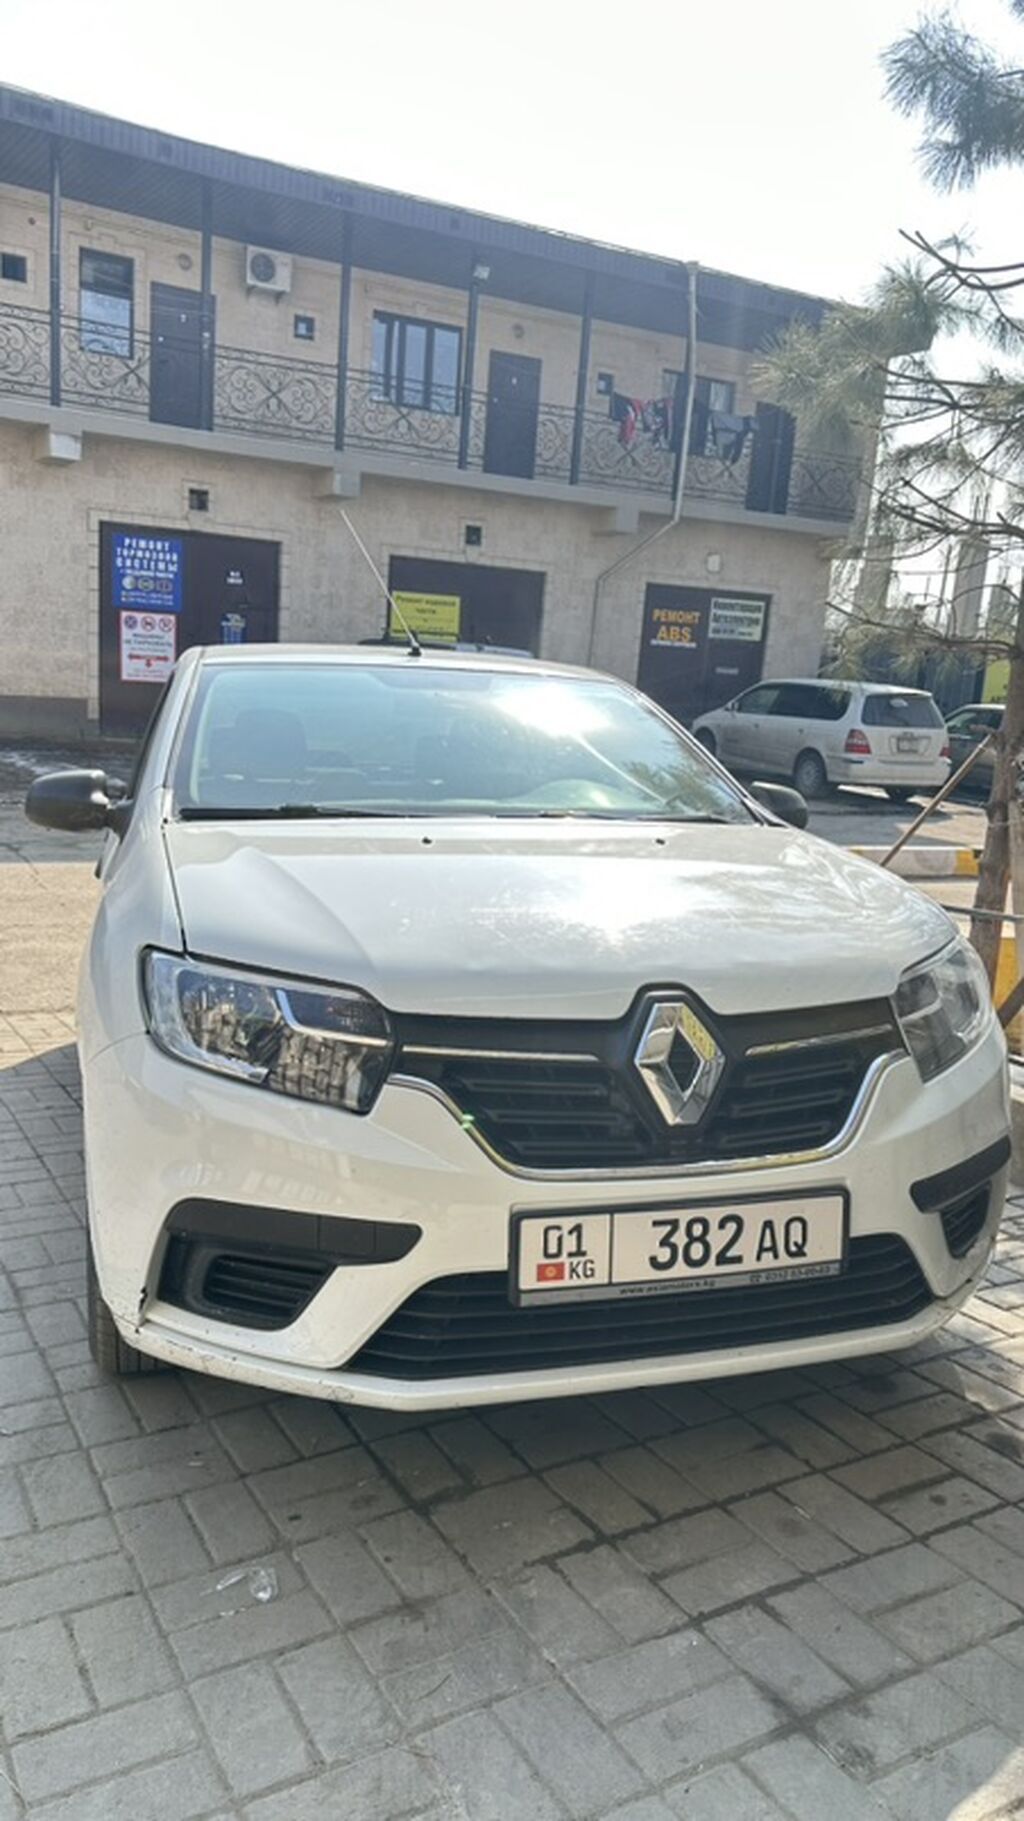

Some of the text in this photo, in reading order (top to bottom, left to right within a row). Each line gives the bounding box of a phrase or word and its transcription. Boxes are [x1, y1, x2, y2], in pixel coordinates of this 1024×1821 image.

[124, 537, 170, 551] РЕМОНТ
[116, 557, 178, 572] СИСТЕМЫ
[652, 608, 701, 624] РЕМОНТ
[656, 625, 692, 642] ABS
[542, 1213, 808, 1272] 01 382 AQ
[569, 1259, 595, 1280] KG
